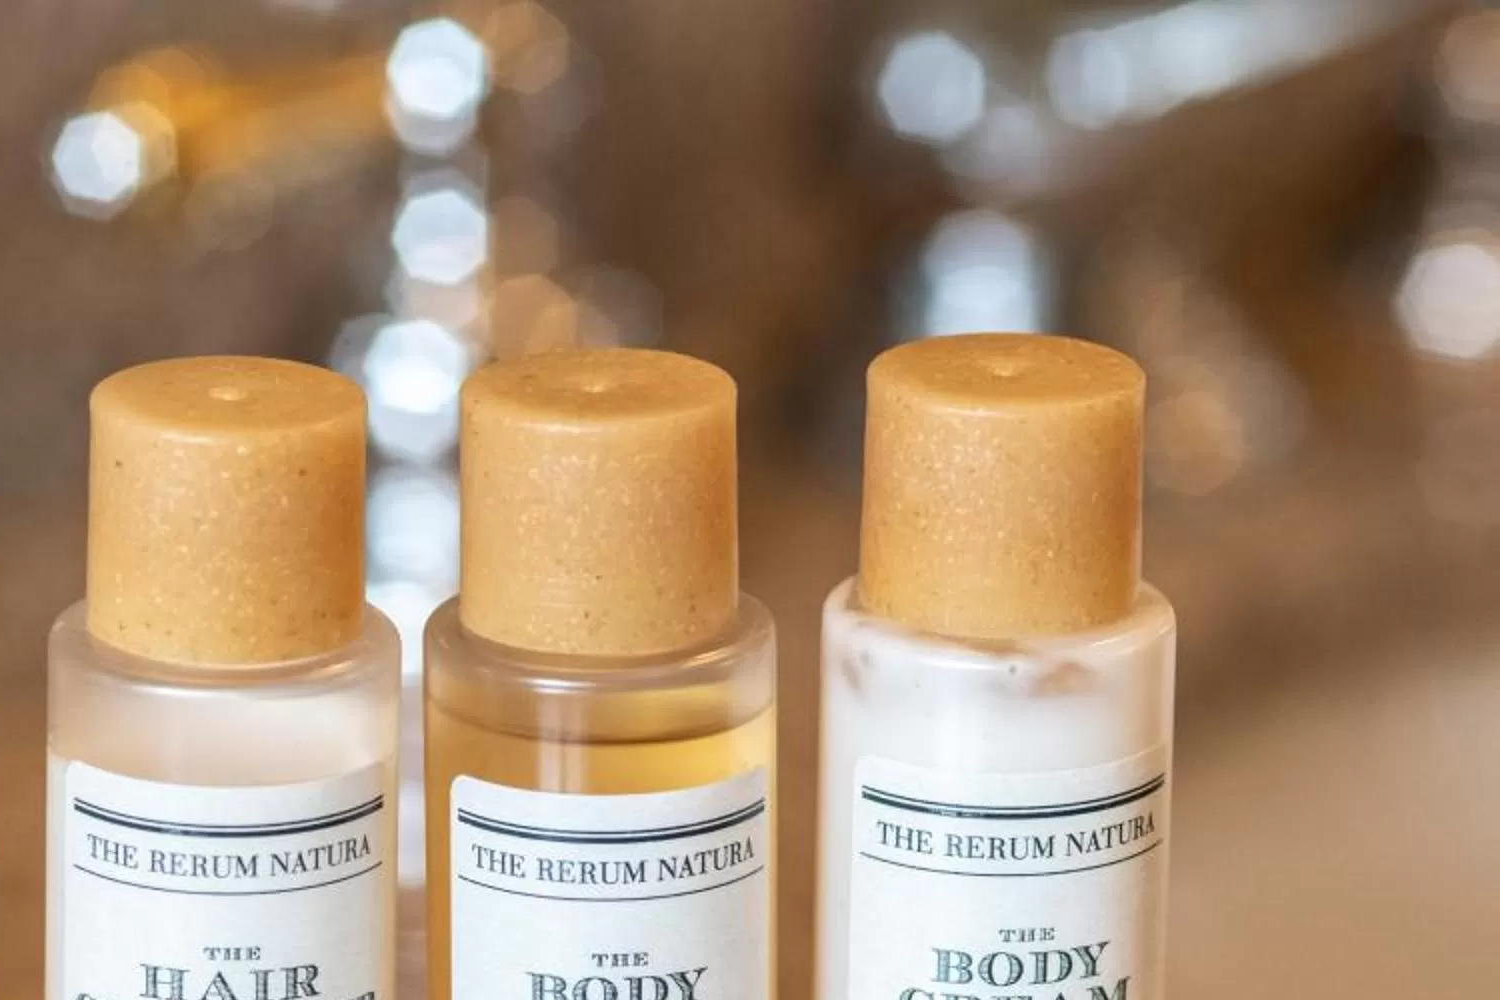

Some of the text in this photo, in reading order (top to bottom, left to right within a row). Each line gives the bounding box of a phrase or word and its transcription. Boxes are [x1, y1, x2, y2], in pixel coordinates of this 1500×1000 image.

[87, 833, 370, 879] THE RERUM NATURA
[876, 812, 1155, 860] THE RERUM NATURA
[471, 837, 755, 885] THE RERUM NATURA
[203, 946, 261, 961] THE
[999, 927, 1056, 943] THE
[591, 952, 649, 968] THE
[931, 940, 1111, 987] BODY
